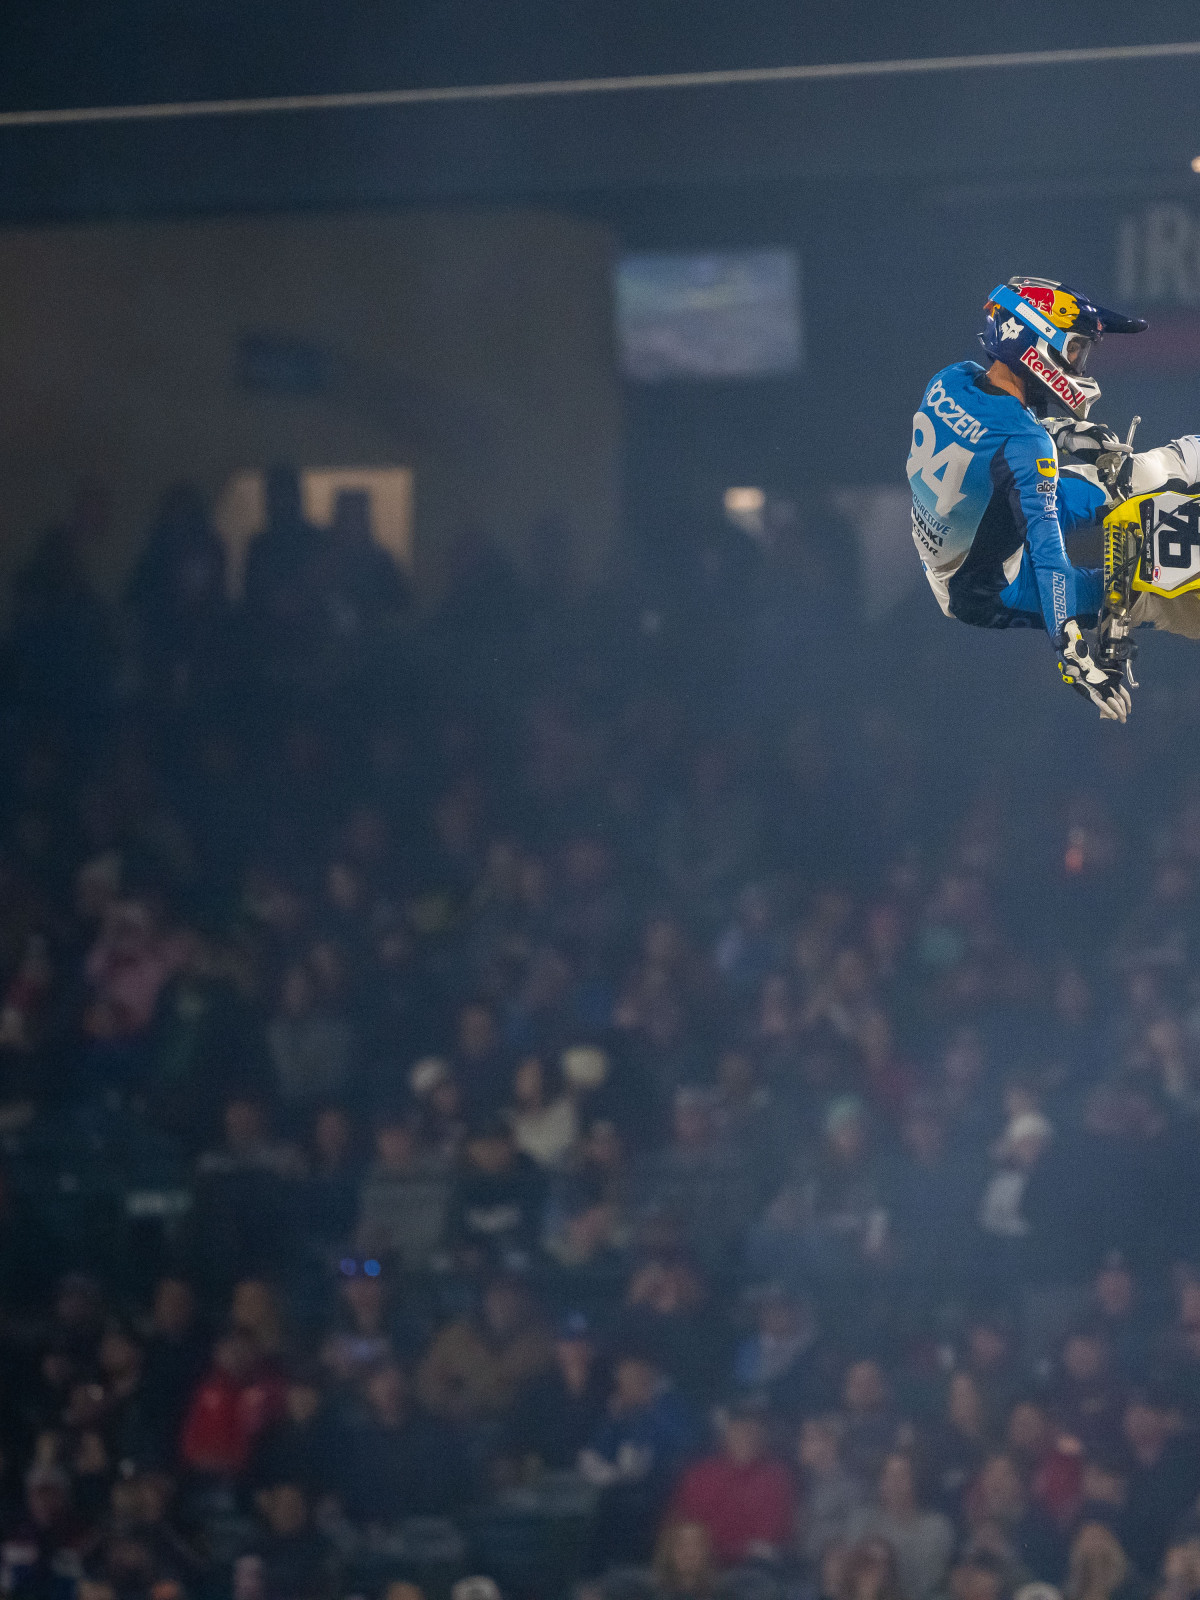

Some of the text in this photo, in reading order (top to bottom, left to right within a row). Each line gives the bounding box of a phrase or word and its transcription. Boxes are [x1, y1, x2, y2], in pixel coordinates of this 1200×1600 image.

[926, 379, 988, 445] ROCZEN
[906, 411, 975, 518] 94
[912, 493, 951, 535] OGRESSIVE
[912, 508, 944, 547] UZUKI
[913, 523, 939, 556] CSTAR
[1052, 571, 1068, 631] PROGRE
